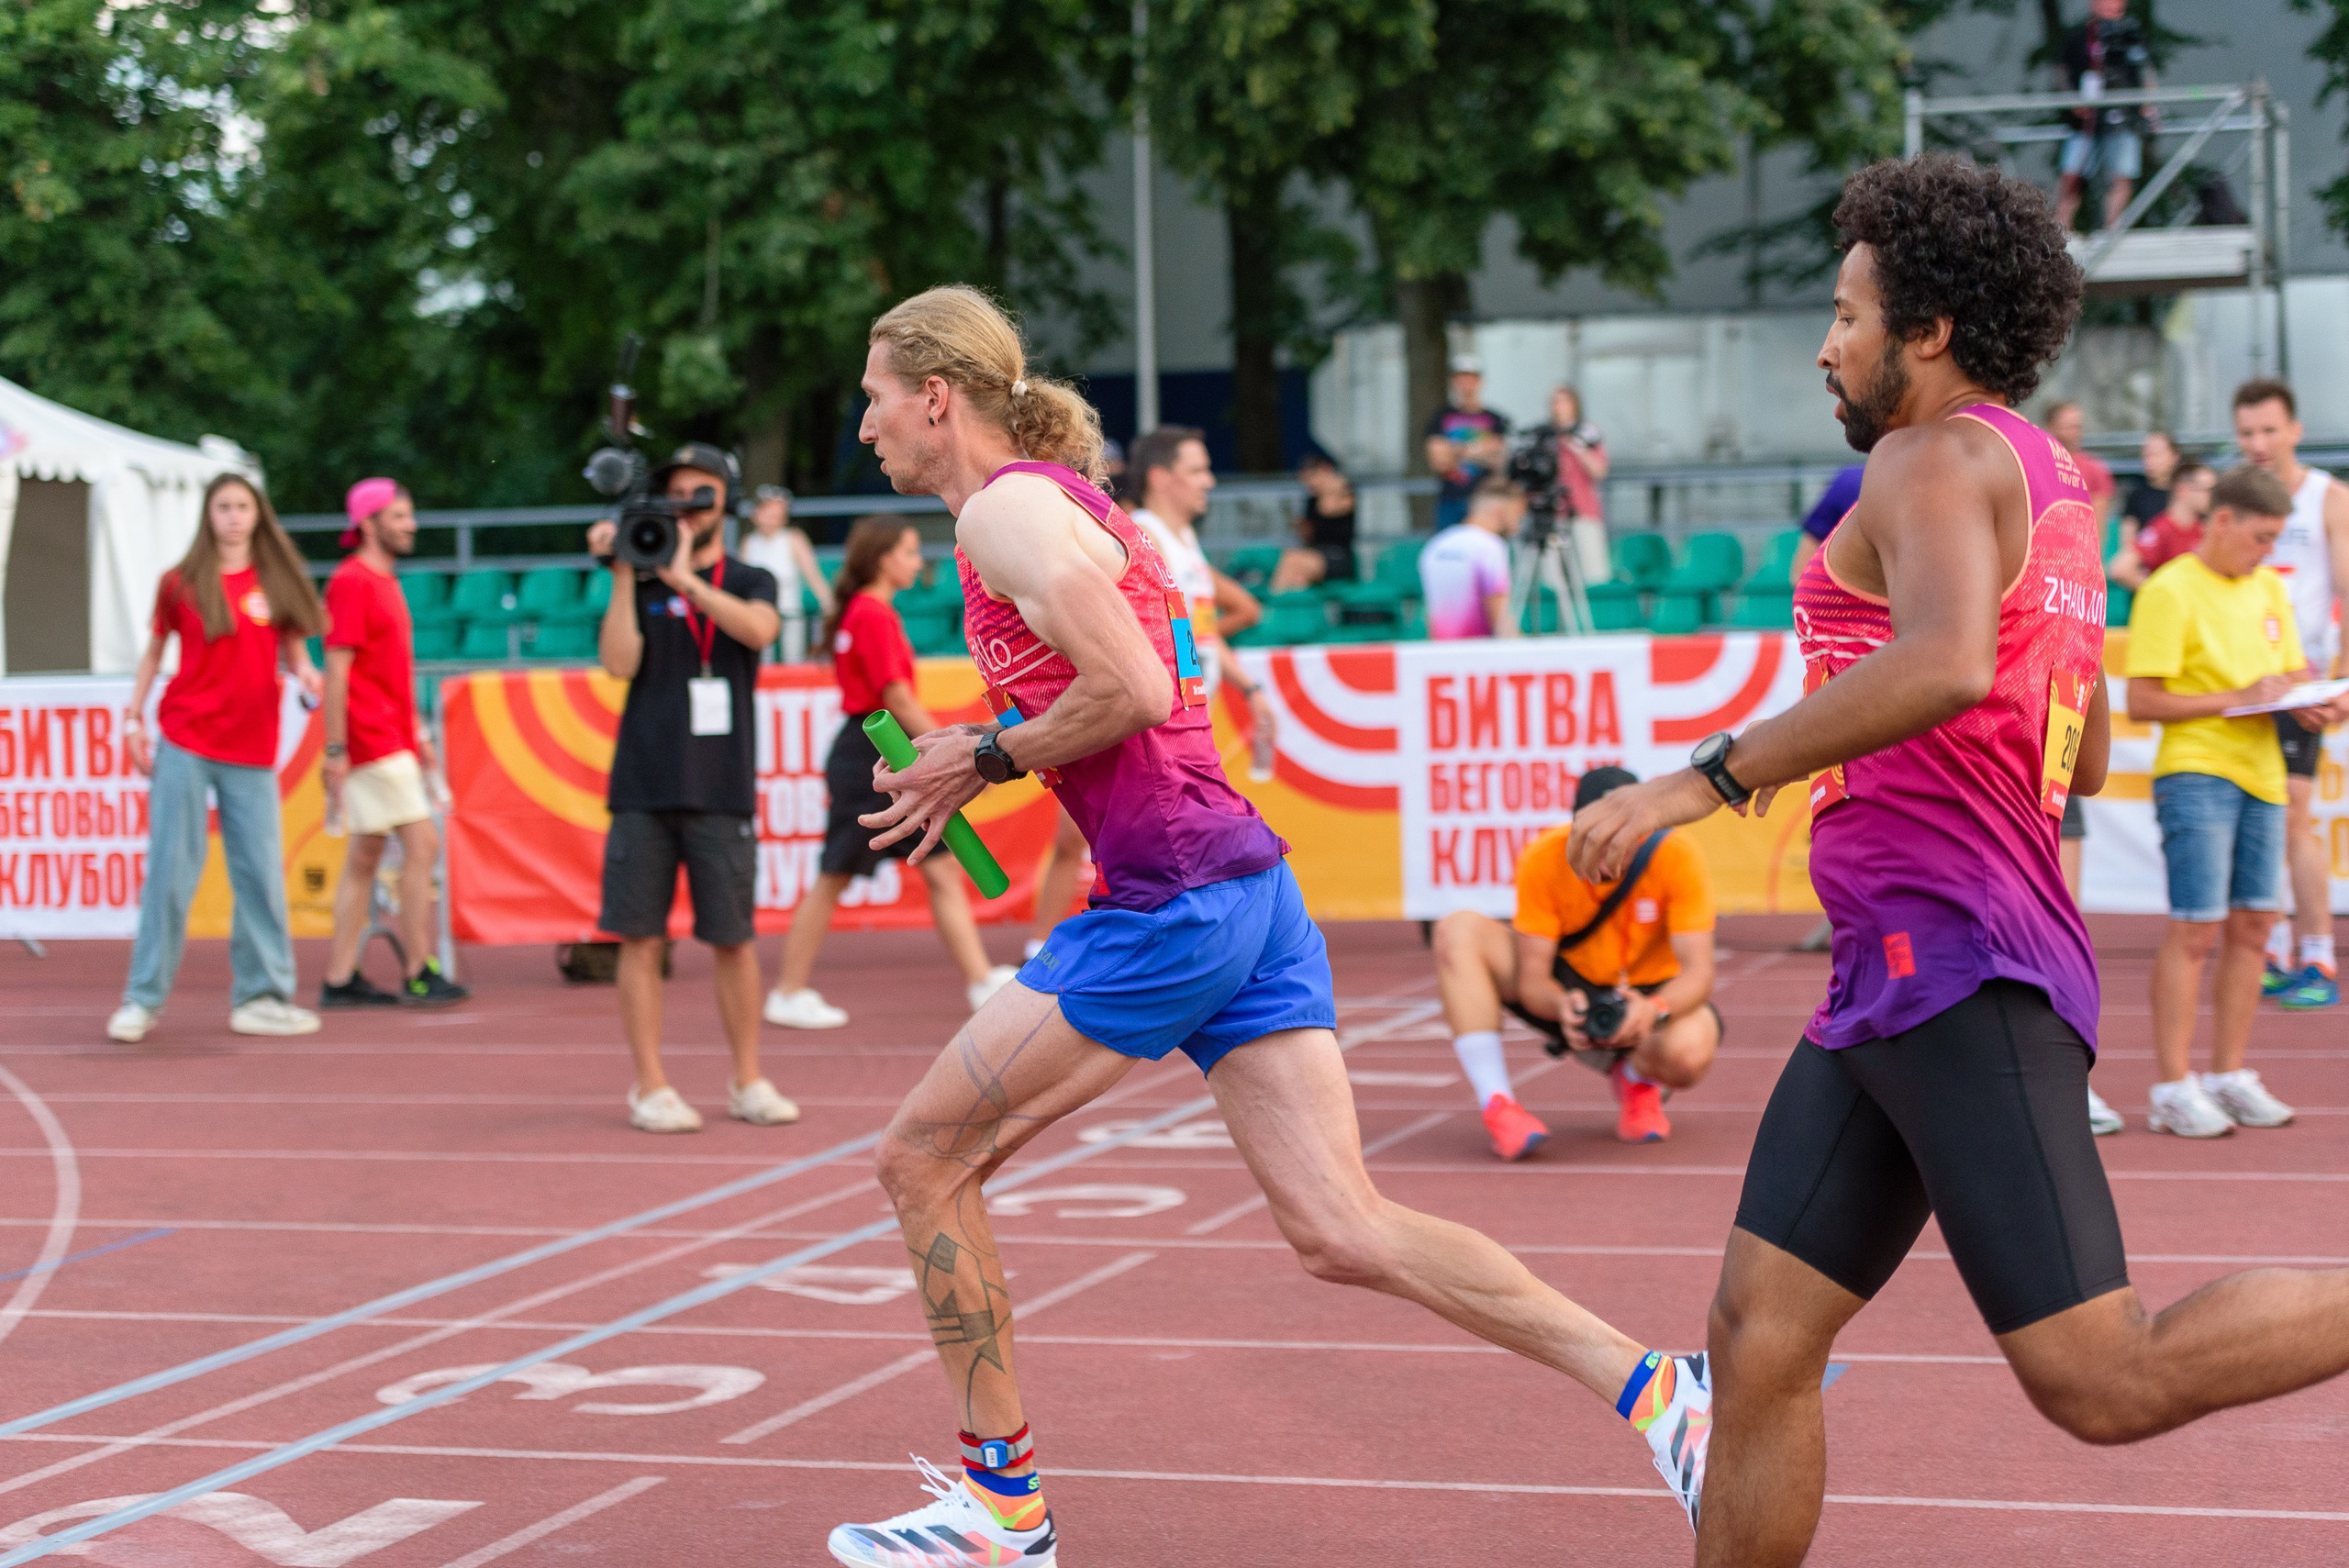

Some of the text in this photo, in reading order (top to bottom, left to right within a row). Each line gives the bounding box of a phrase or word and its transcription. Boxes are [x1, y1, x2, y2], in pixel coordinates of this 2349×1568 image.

[1428, 671, 1621, 751] БИТВА
[1430, 761, 1621, 814] БЕГОВЫ
[1431, 828, 1551, 886] КЛУ
[375, 1362, 767, 1416] 3
[0, 1490, 486, 1568] 2
